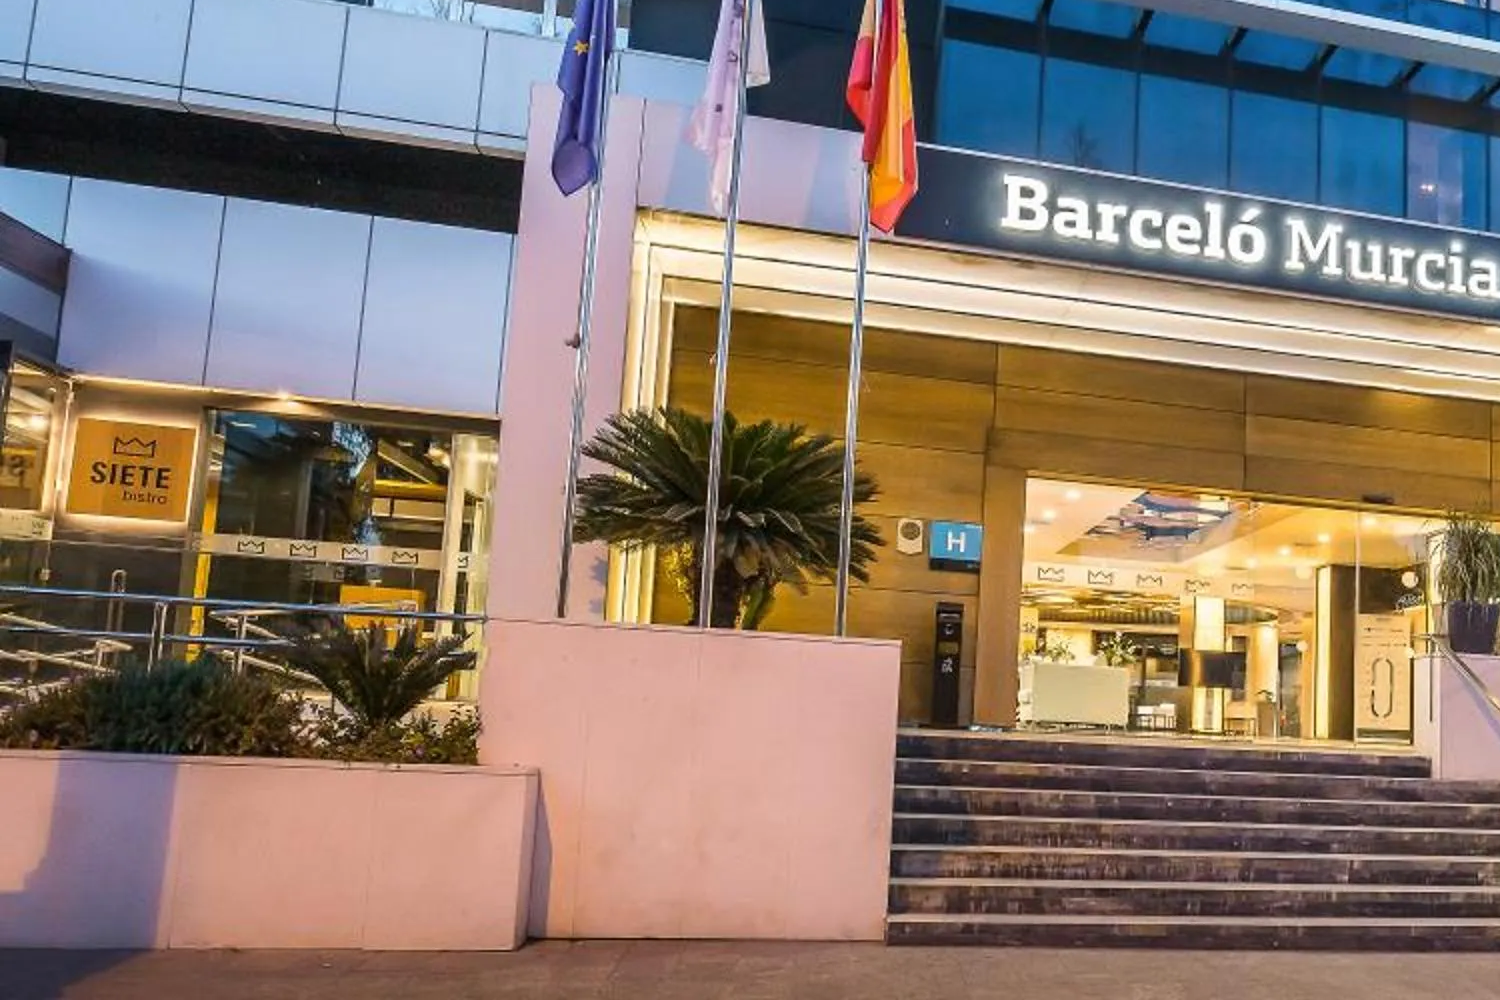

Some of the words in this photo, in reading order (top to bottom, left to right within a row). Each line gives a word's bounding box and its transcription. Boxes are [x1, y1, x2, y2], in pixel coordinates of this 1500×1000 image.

[1000, 173, 1267, 264] Barceló
[90, 461, 172, 489] SIETE
[947, 531, 966, 553] H
